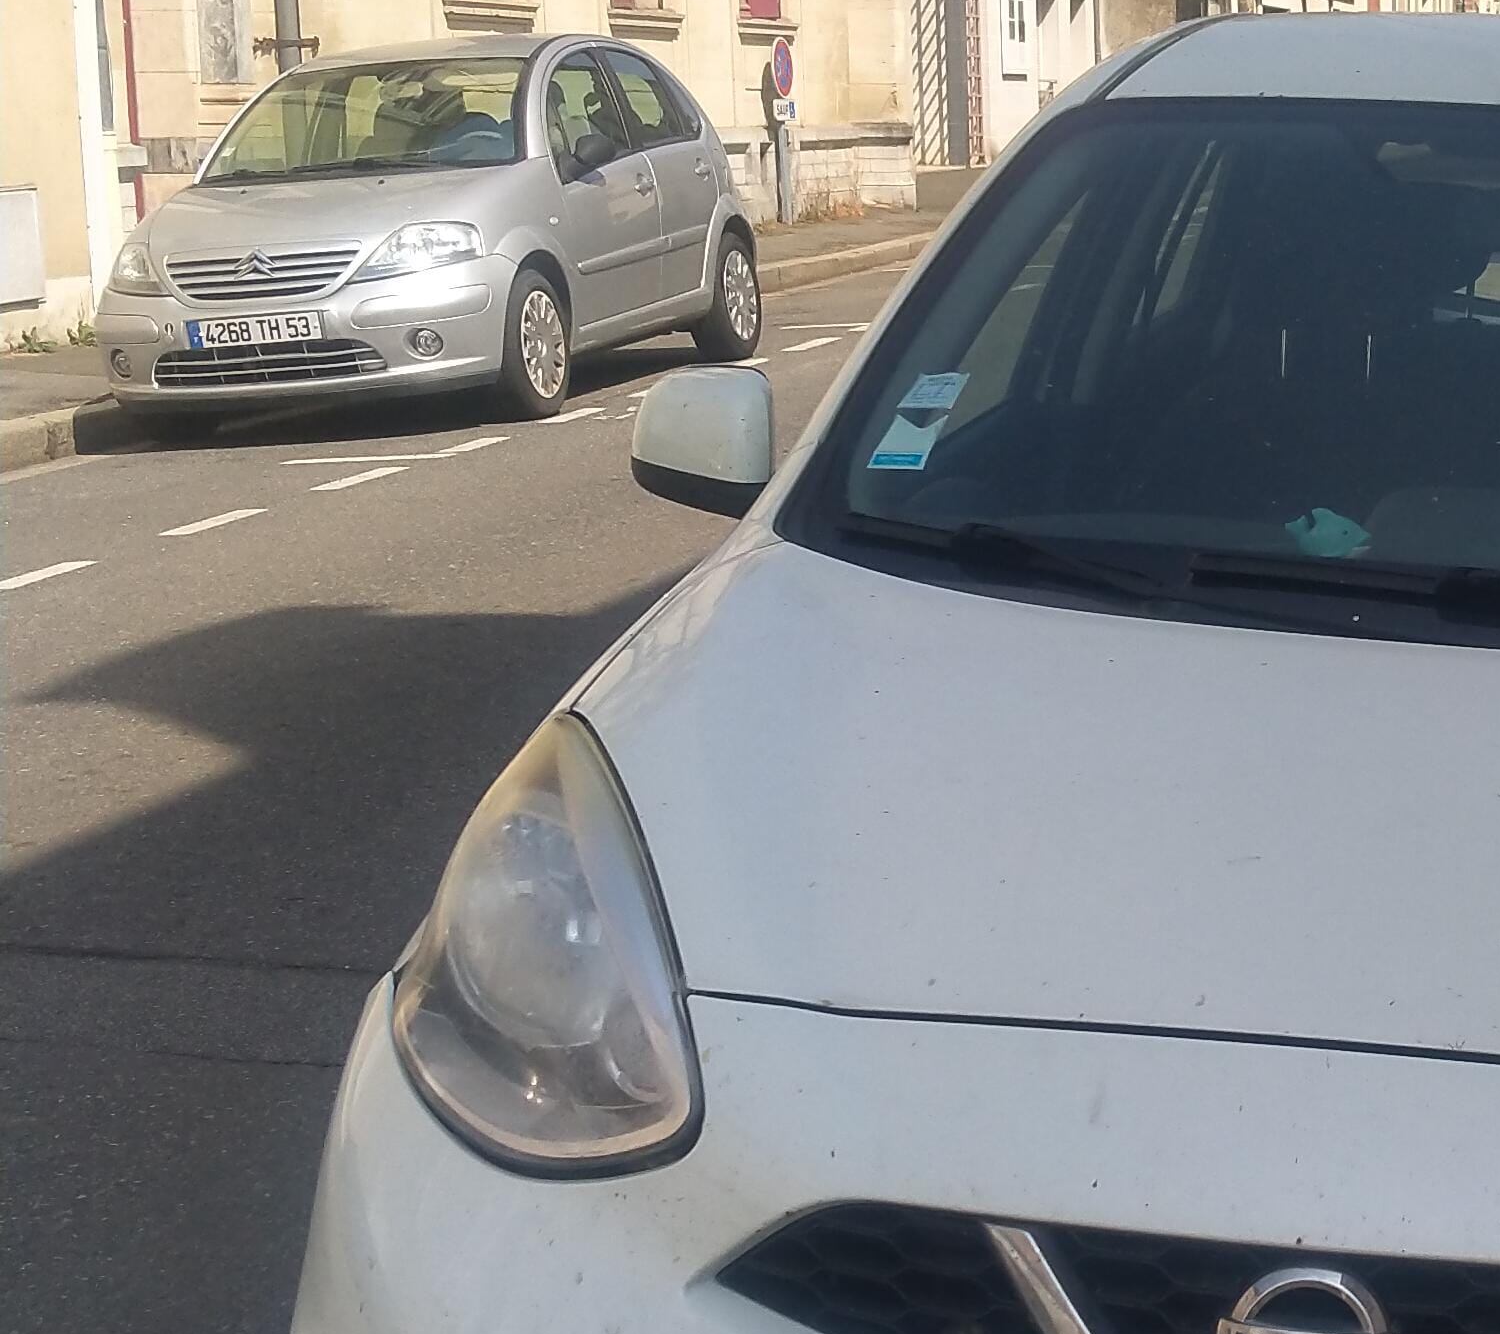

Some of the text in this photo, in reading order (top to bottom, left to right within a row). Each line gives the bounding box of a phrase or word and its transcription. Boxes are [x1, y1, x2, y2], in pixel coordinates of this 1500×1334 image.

[205, 321, 252, 344] 4268
[256, 319, 281, 340] TH
[285, 316, 312, 338] 53
